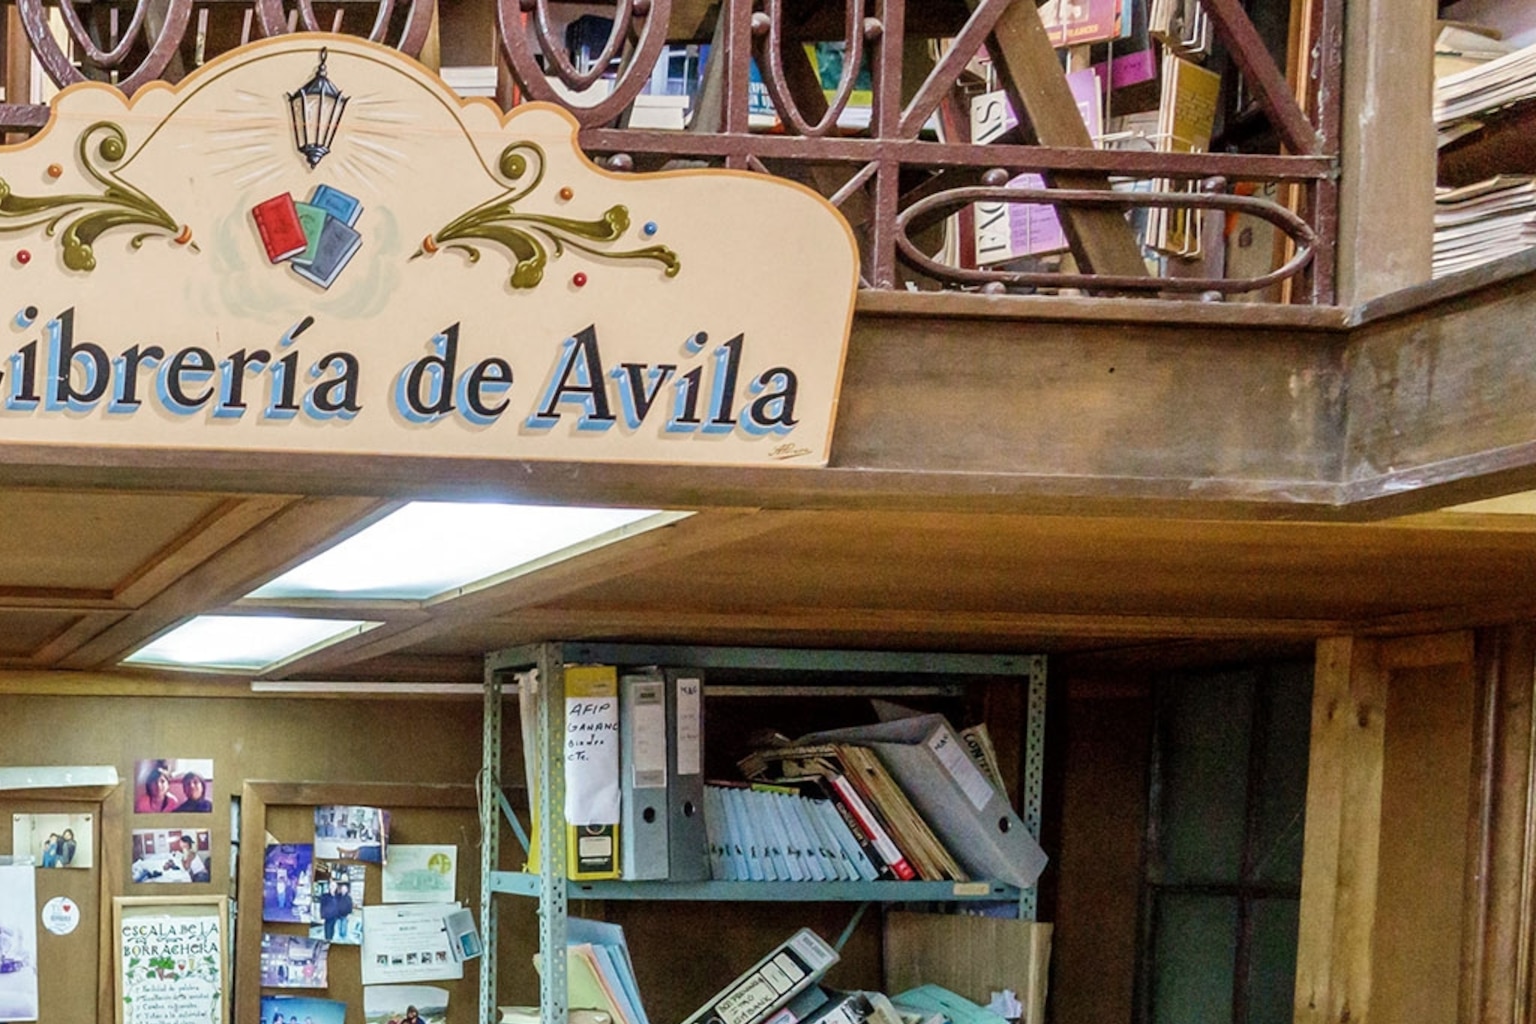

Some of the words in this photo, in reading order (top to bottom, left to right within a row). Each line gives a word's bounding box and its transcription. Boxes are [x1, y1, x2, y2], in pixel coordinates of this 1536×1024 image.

[395, 322, 514, 426] de
[526, 324, 799, 438] Avila
[570, 703, 611, 716] AFIP
